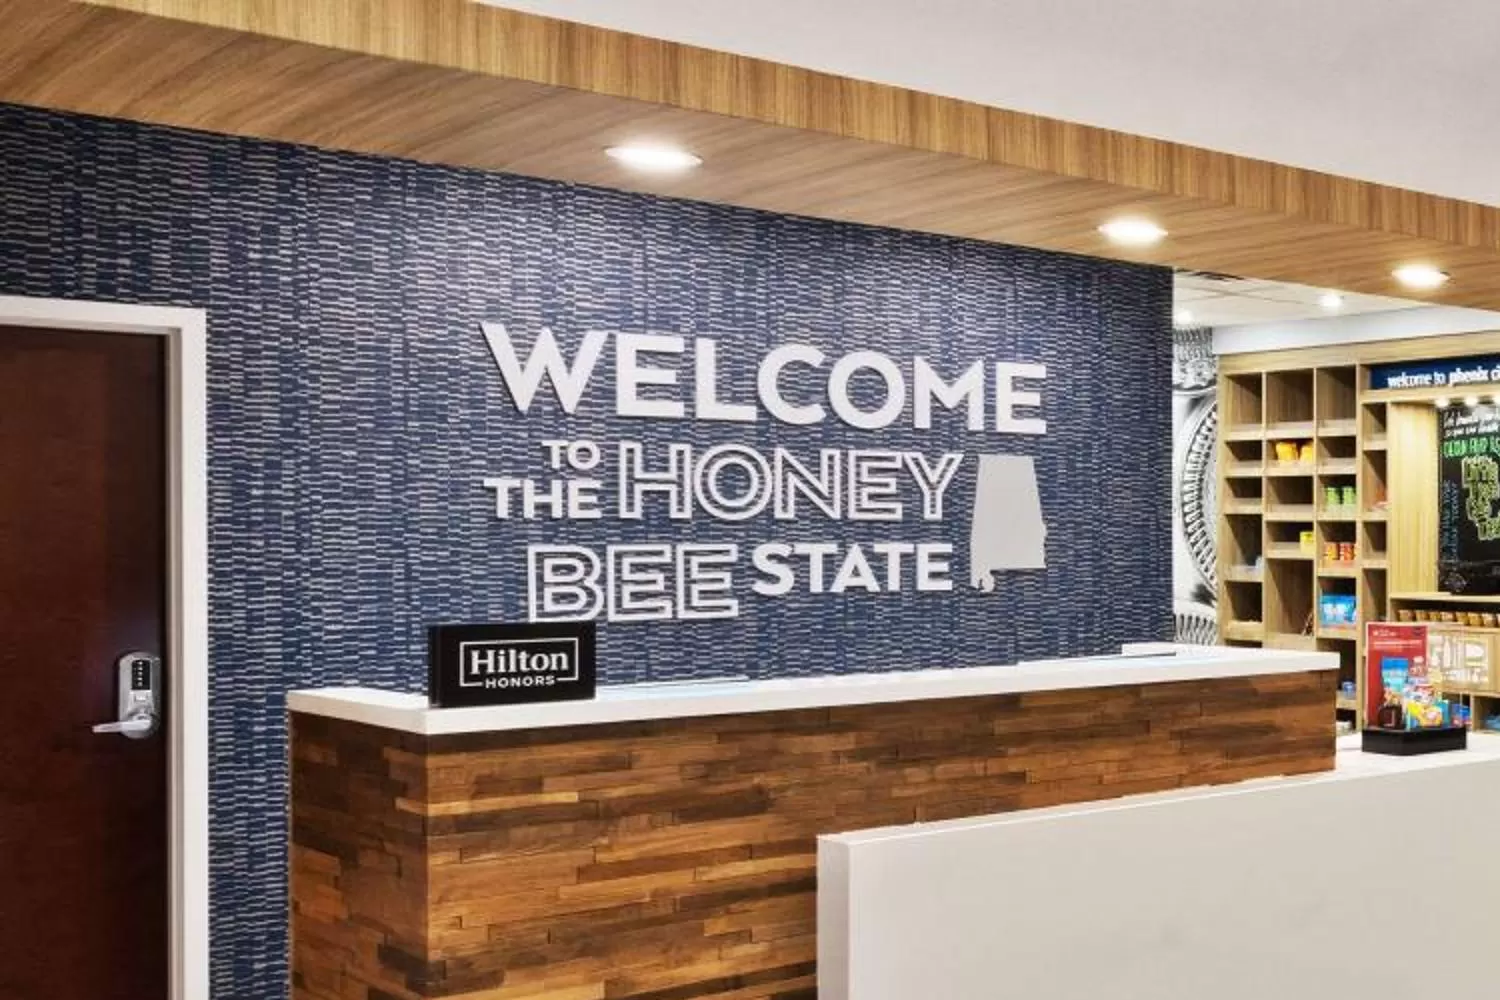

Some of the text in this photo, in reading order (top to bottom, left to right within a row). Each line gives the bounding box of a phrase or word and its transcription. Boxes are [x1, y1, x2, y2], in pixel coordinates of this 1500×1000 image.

[479, 320, 1047, 434] WELCOME
[1387, 372, 1433, 388] welcome
[1433, 371, 1446, 385] to
[541, 440, 600, 470] TO
[483, 440, 965, 521] THE HONEY
[527, 543, 953, 623] BEE STATE
[470, 648, 570, 675] Hilton
[485, 675, 556, 689] HONORS
